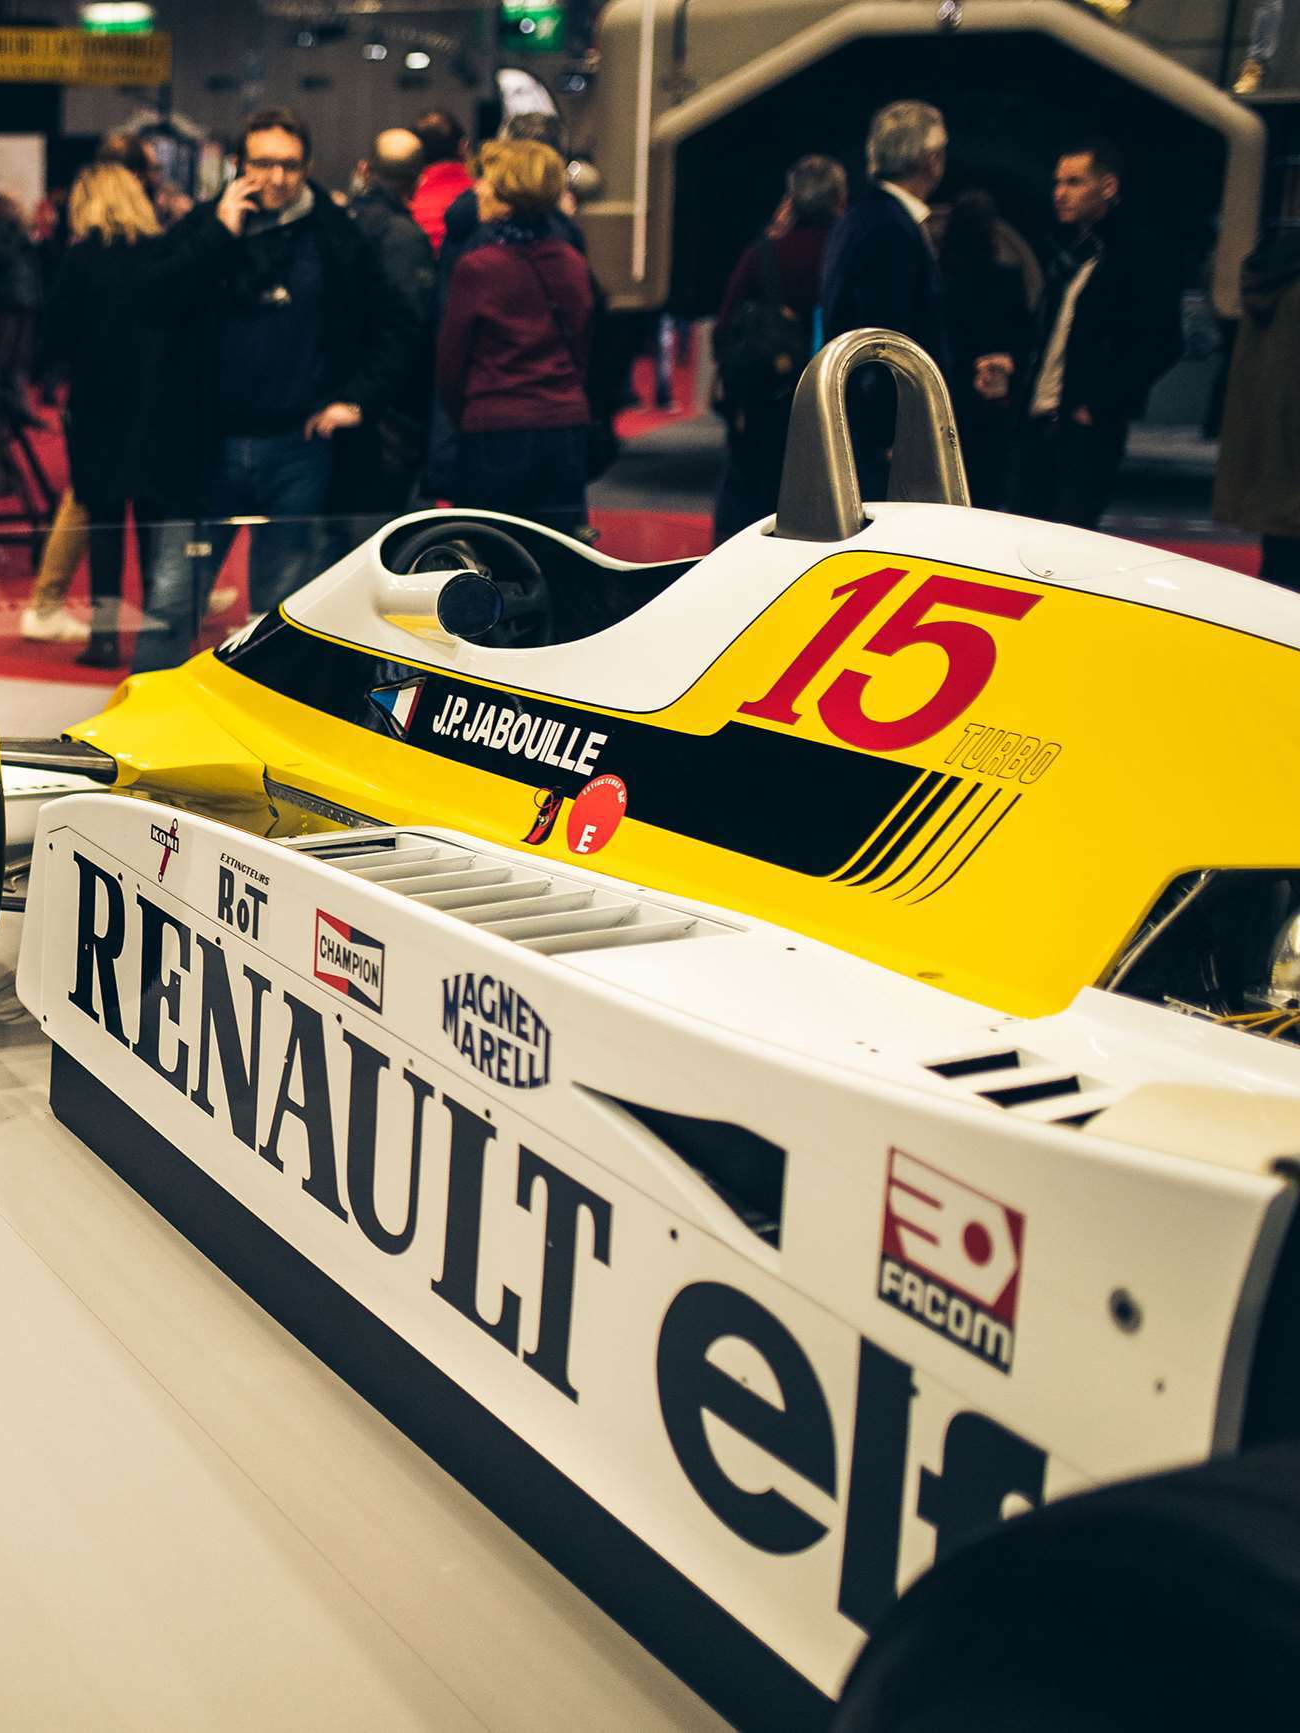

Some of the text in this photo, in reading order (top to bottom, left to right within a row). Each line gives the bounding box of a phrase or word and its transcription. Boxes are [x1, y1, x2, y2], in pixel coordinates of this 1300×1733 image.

[736, 566, 1045, 752] 15
[944, 722, 1062, 784] TURBO
[152, 827, 178, 851] KONI
[576, 824, 598, 853] E
[220, 852, 270, 886] EXTINCTEURS
[319, 935, 380, 988] CHAMPION
[68, 851, 613, 1404] RENAULT
[881, 1260, 1013, 1364] FACOM
